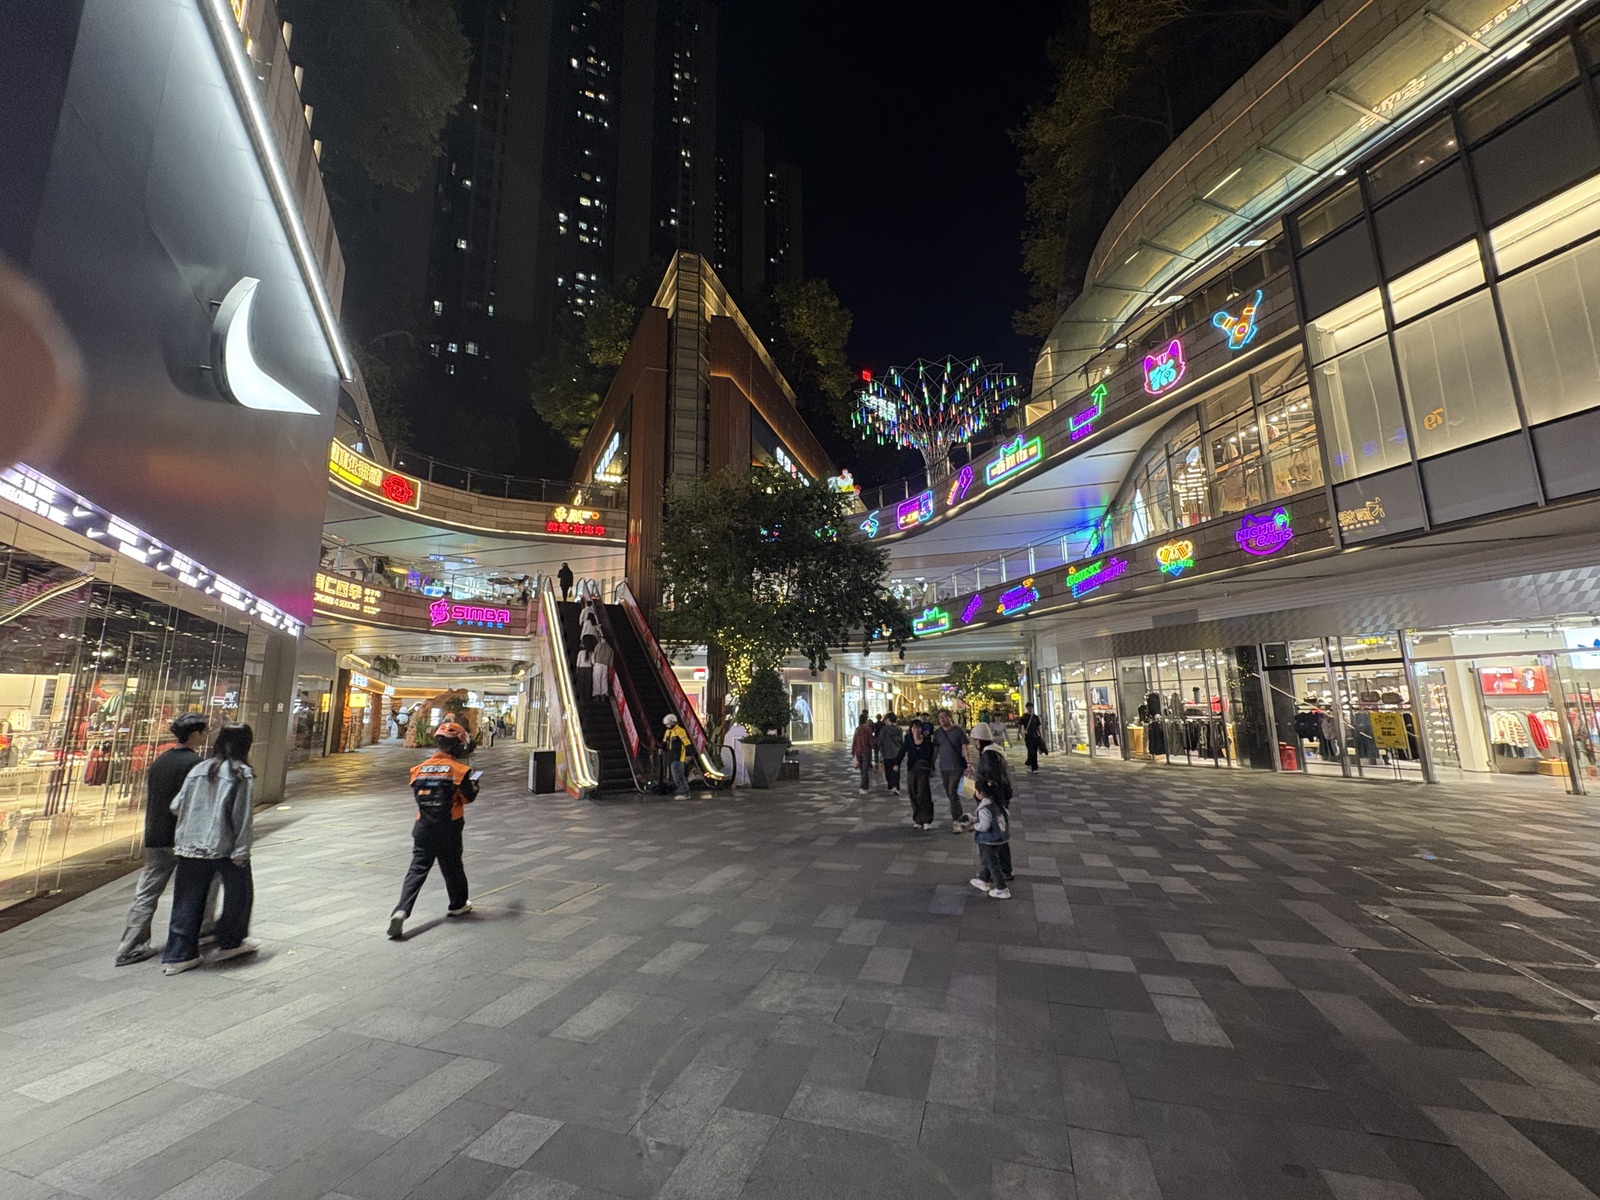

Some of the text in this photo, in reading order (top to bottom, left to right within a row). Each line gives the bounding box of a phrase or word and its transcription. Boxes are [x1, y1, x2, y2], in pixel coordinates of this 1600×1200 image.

[1235, 522, 1276, 542] NIGHT
[1256, 528, 1293, 547] CATS
[1066, 561, 1102, 587] DRINK
[1160, 559, 1194, 573] COLD BEER
[452, 605, 510, 624] SIMBA
